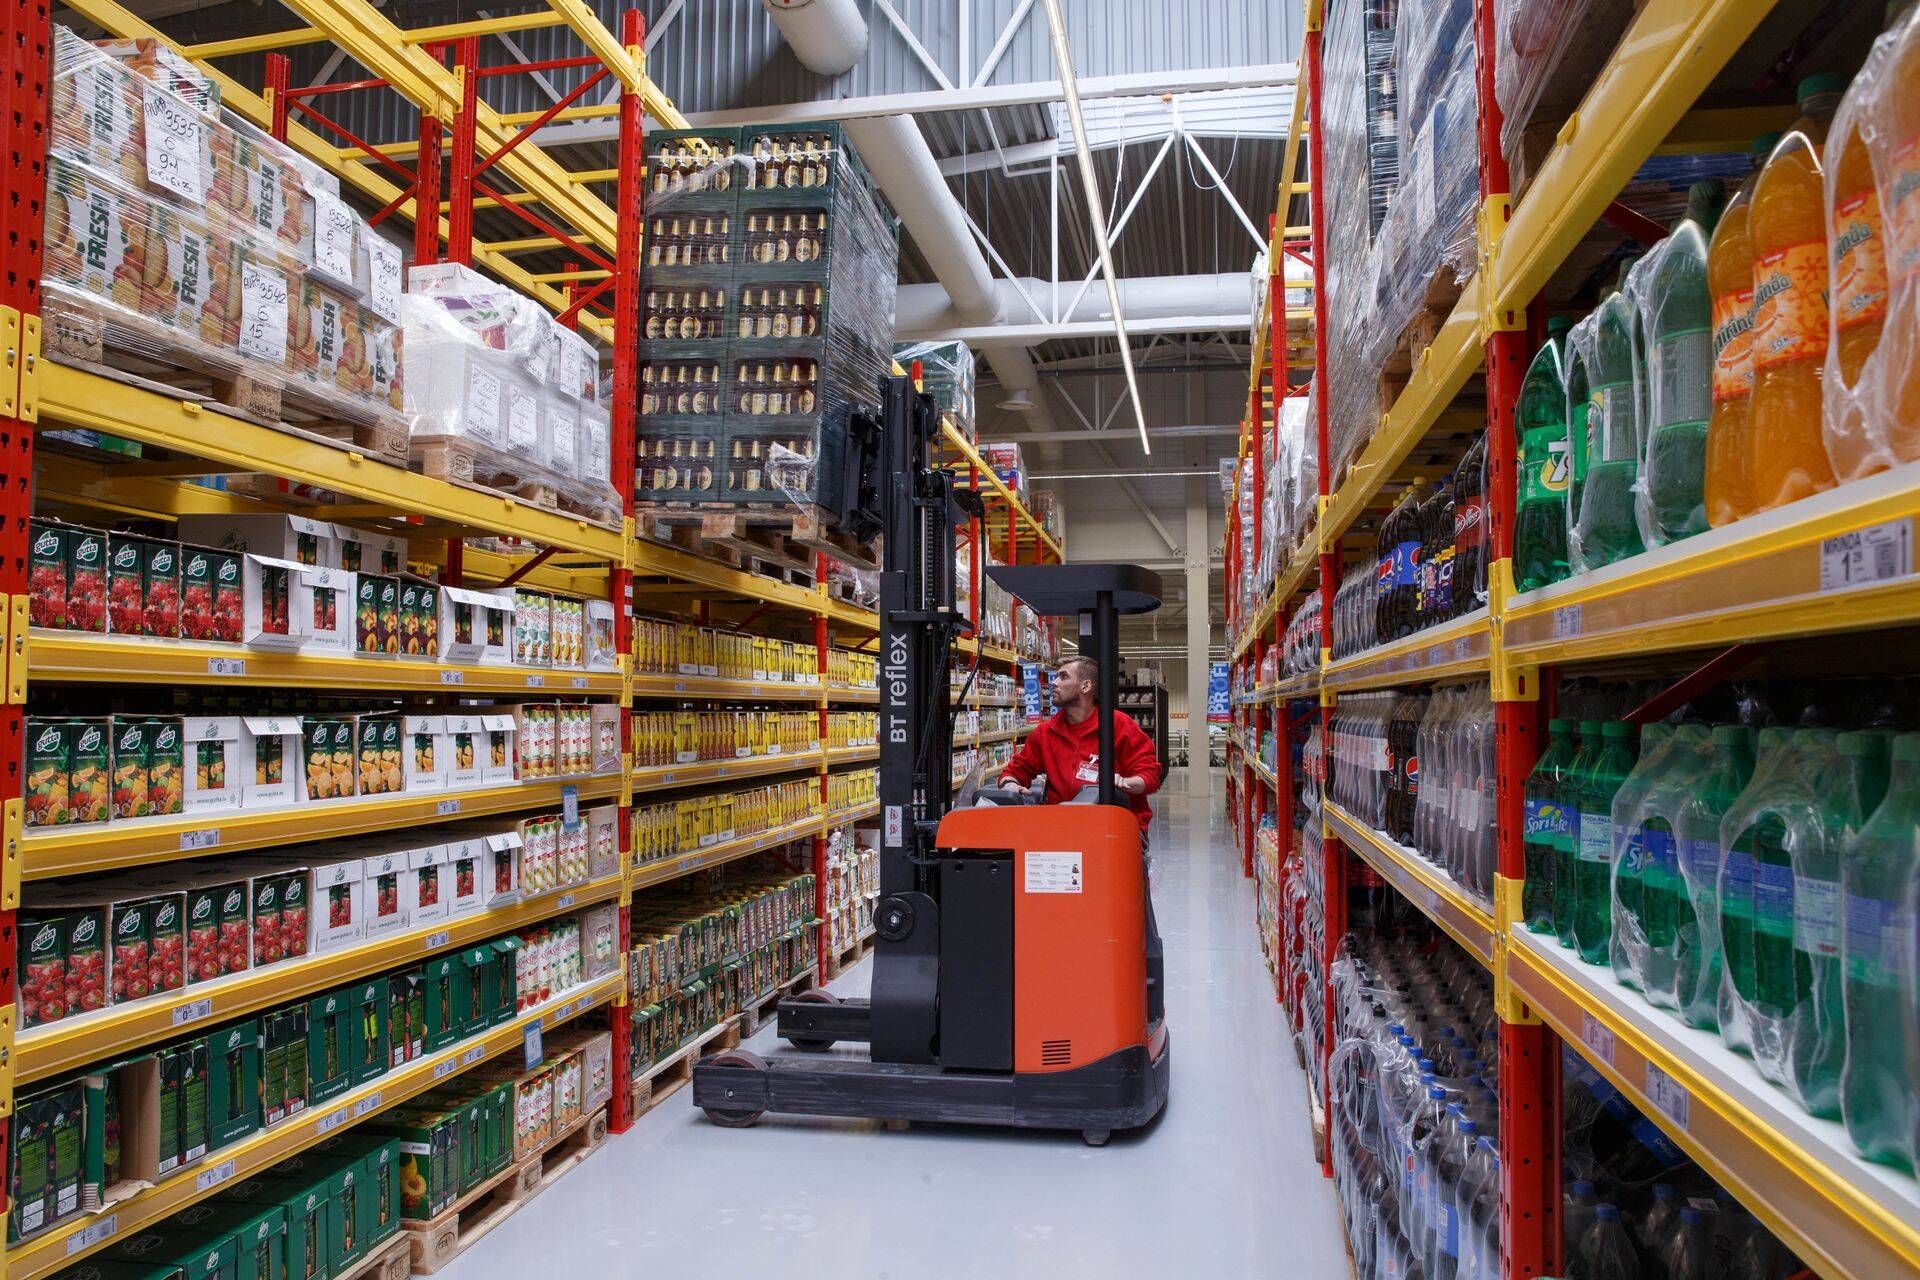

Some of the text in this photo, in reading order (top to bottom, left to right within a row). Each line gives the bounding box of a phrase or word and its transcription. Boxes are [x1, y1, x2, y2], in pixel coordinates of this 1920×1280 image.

[164, 110, 197, 137] 3535
[259, 164, 275, 229] FRESH
[87, 193, 110, 270] FRESH
[181, 235, 200, 305] FRESH
[260, 283, 286, 304] 3542
[258, 306, 268, 321] 6
[249, 324, 264, 339] 15
[322, 302, 335, 361] FRESH
[35, 537, 58, 553] gutta
[77, 544, 98, 560] gutta
[115, 548, 136, 565] gutta
[152, 554, 171, 570] gutta
[1842, 552, 1849, 581] 1
[218, 663, 222, 672] 0
[886, 634, 907, 742] BT reflex
[1023, 664, 1039, 715] PROFI
[1213, 662, 1229, 714] PROFI
[36, 732, 60, 752] gutta
[79, 732, 100, 751] gutta
[121, 731, 142, 749] gutta
[157, 731, 175, 748] gutta
[190, 837, 195, 846] 1
[119, 913, 140, 934] gutta
[156, 906, 175, 927] gutta
[32, 928, 56, 952] gutta
[73, 920, 95, 942] gutta
[182, 1010, 188, 1020] 0
[207, 1176, 212, 1184] 1
[81, 1235, 86, 1244] 1
